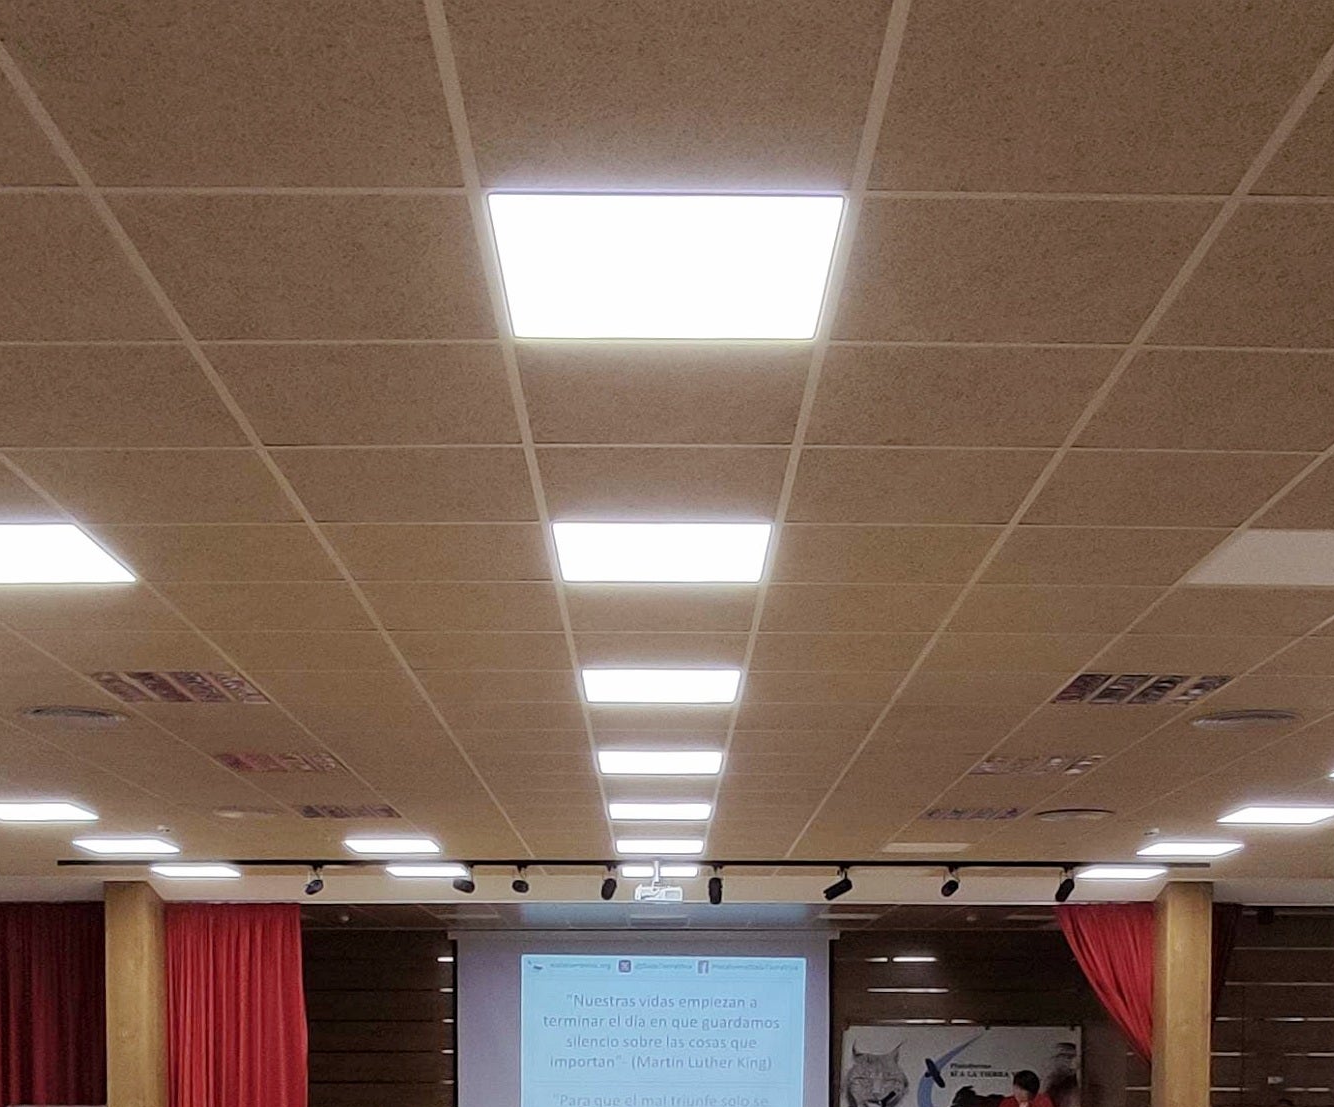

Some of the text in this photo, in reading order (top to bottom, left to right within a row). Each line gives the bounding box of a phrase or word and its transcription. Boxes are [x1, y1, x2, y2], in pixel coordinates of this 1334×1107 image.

[567, 993, 757, 1011] "Nuestras vidas empiezan a
[543, 1015, 604, 1028] terminar
[608, 1015, 621, 1028] el
[650, 1018, 668, 1028] en
[671, 1018, 699, 1031] que
[701, 1016, 780, 1032] guardamos
[566, 1034, 757, 1052] silencio sobre las cosas que
[688, 1056, 732, 1069] Luther
[737, 1057, 772, 1072] King)
[552, 1093, 591, 1107] "Para
[624, 1093, 637, 1107] el
[641, 1095, 667, 1107] mal
[670, 1095, 717, 1107] triunfe
[720, 1095, 750, 1107] solo
[753, 1098, 769, 1107] se
